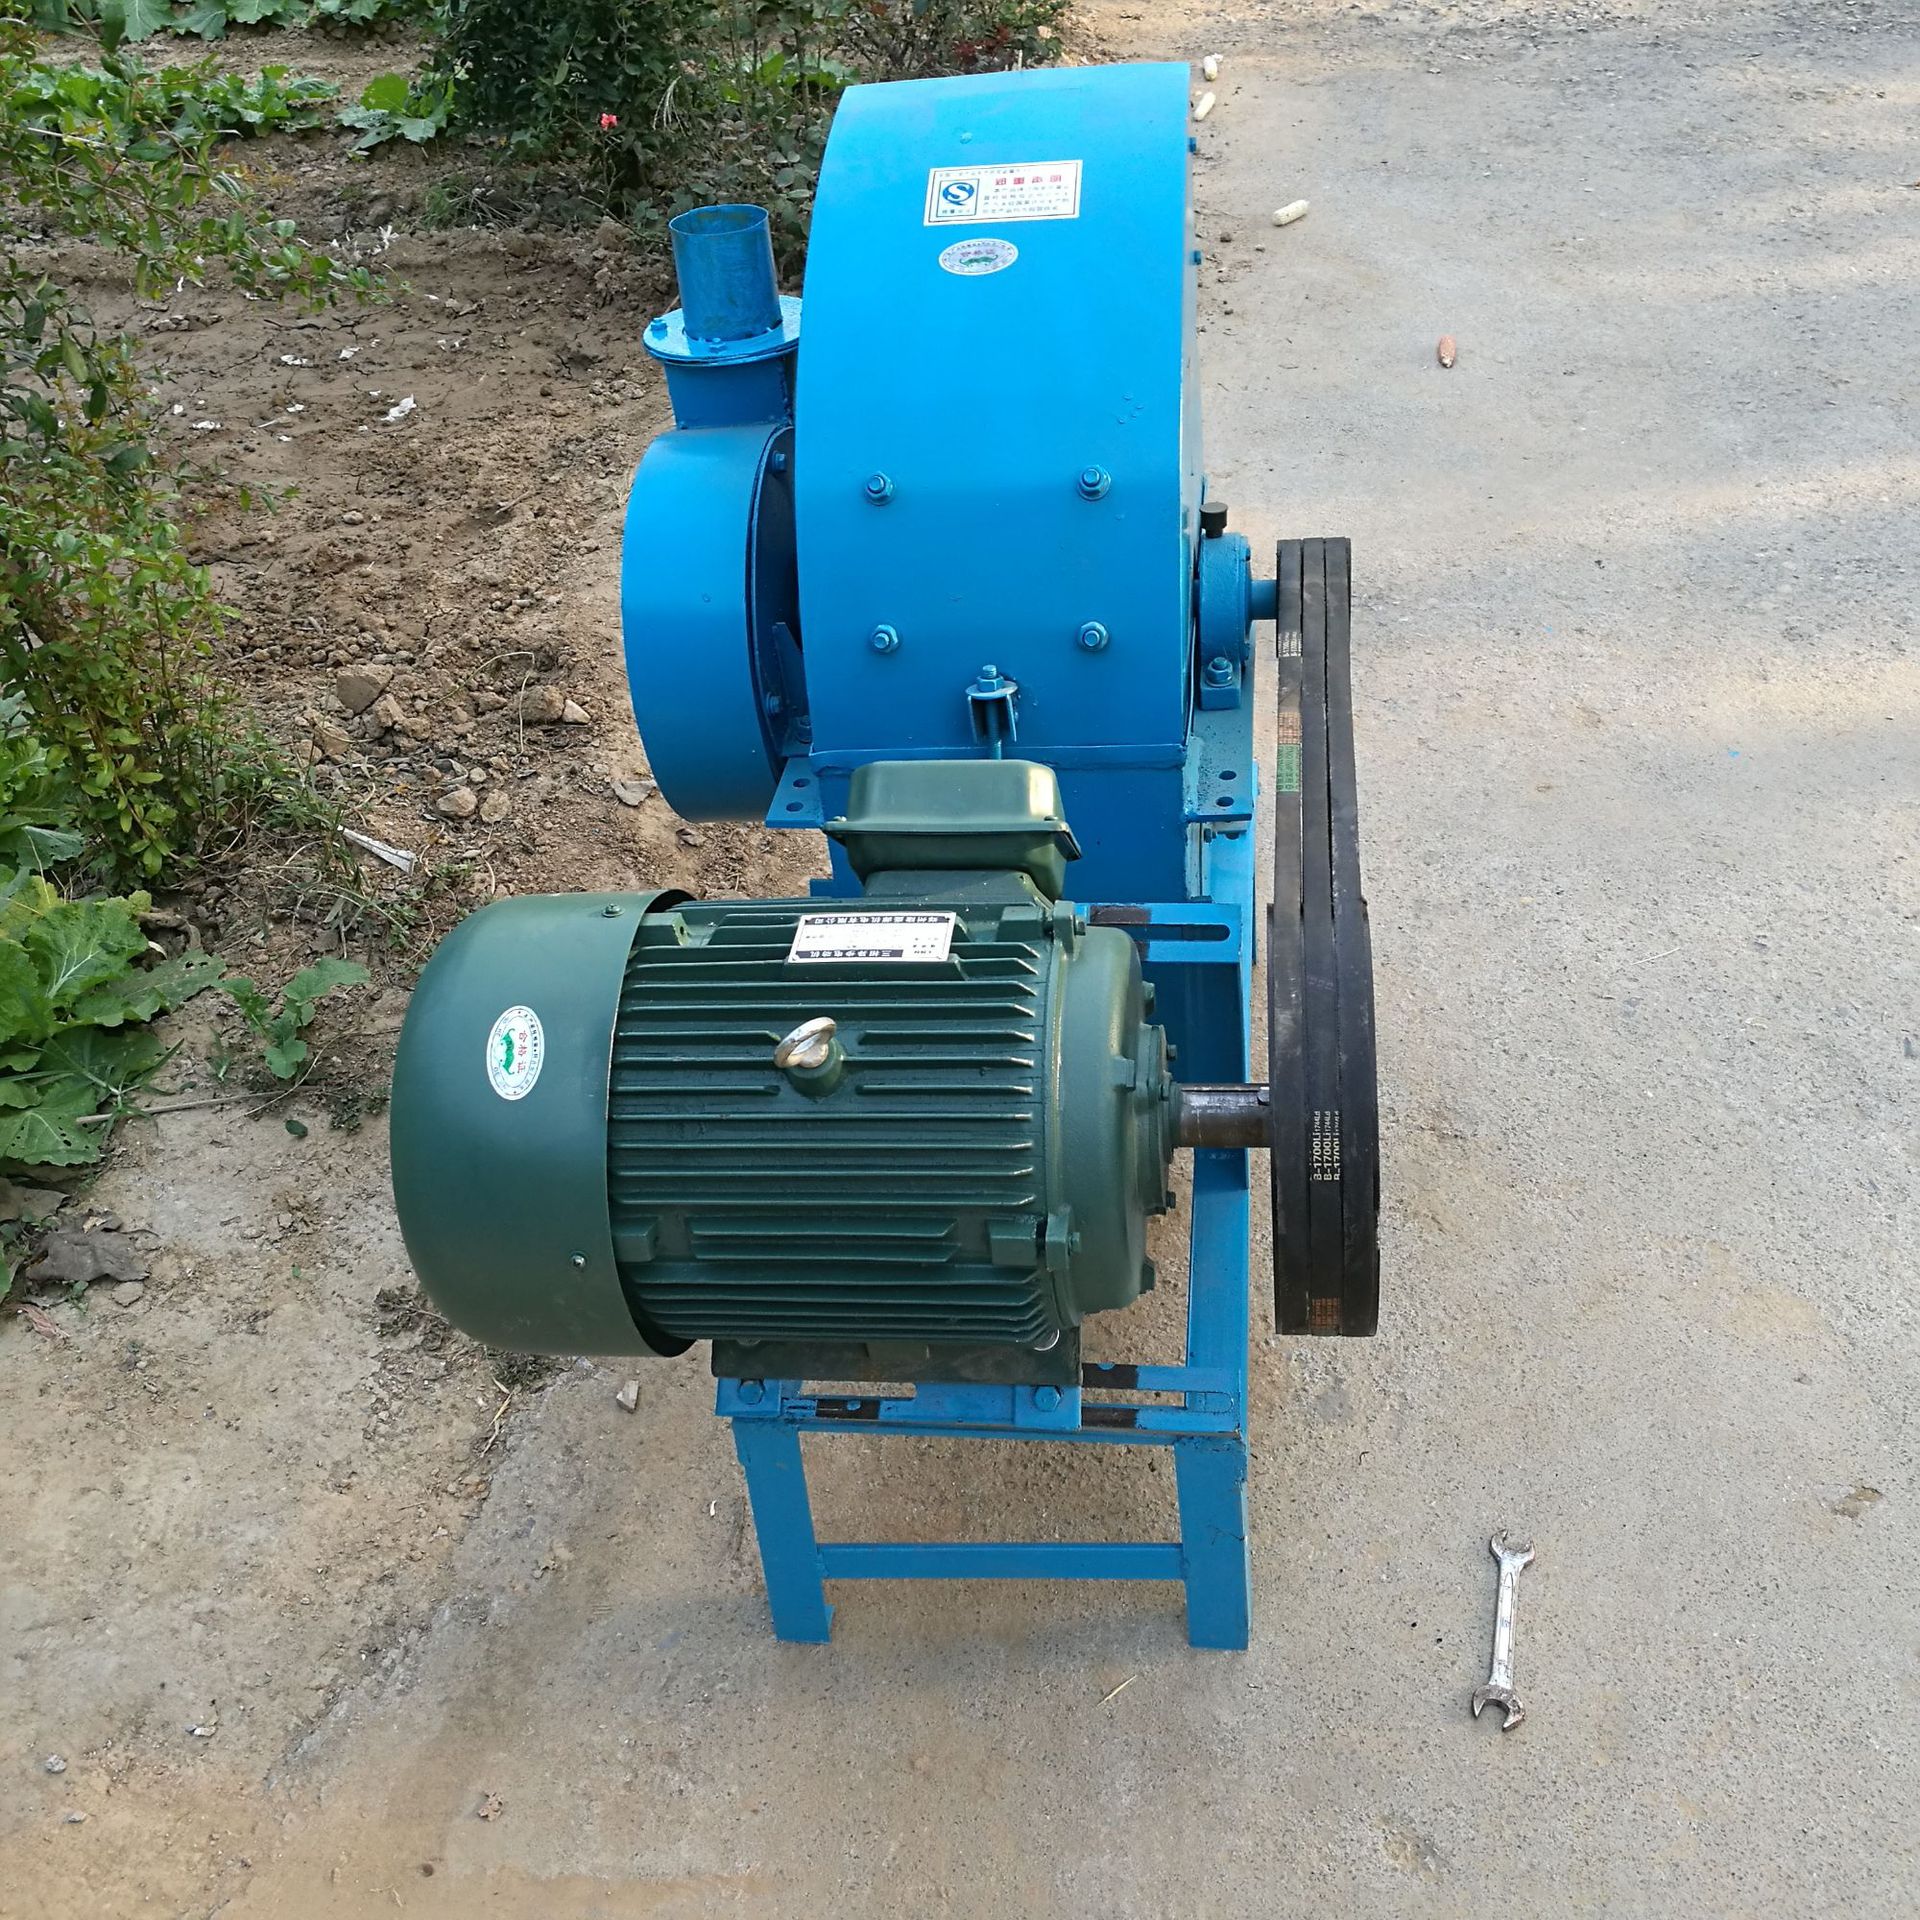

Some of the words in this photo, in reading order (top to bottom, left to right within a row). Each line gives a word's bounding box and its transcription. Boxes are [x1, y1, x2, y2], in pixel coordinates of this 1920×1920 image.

[810, 949, 892, 958] 三相异步电动机
[517, 1030, 528, 1074] 合格证
